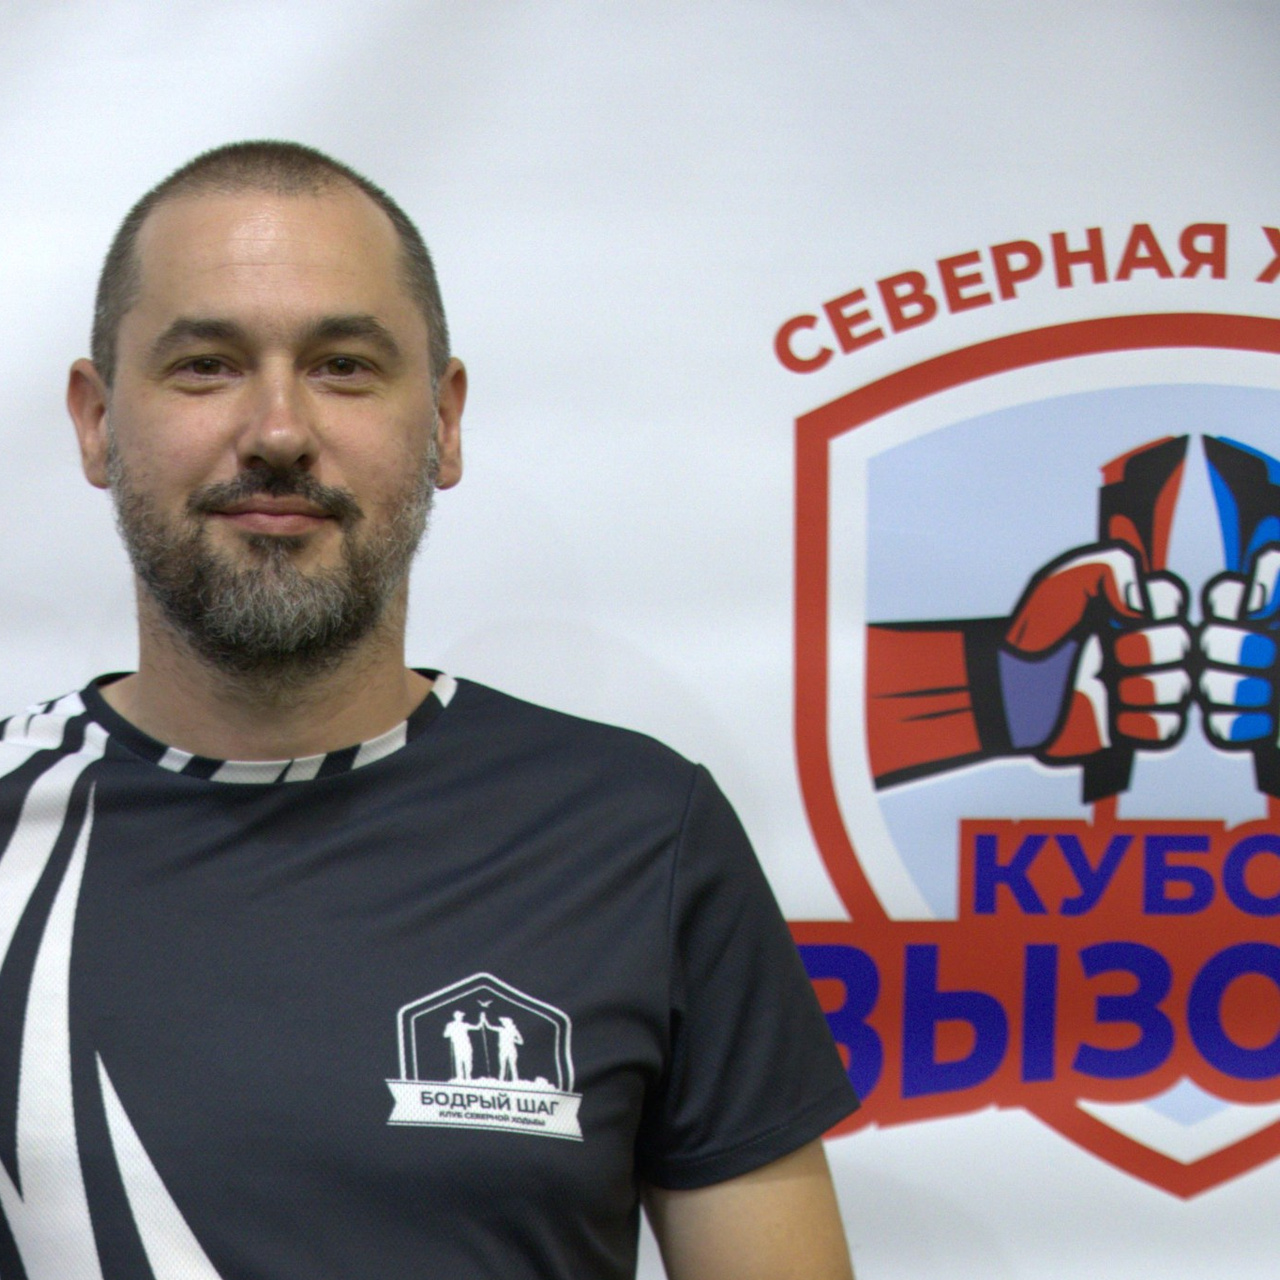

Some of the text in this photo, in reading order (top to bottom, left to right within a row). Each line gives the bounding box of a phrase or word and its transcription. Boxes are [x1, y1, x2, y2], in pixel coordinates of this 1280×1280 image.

[773, 222, 1228, 375] СЕВЕРНАЯ
[420, 1090, 560, 1115] БОДРЫЙ ШАГ
[438, 1110, 463, 1119] КЛУБ
